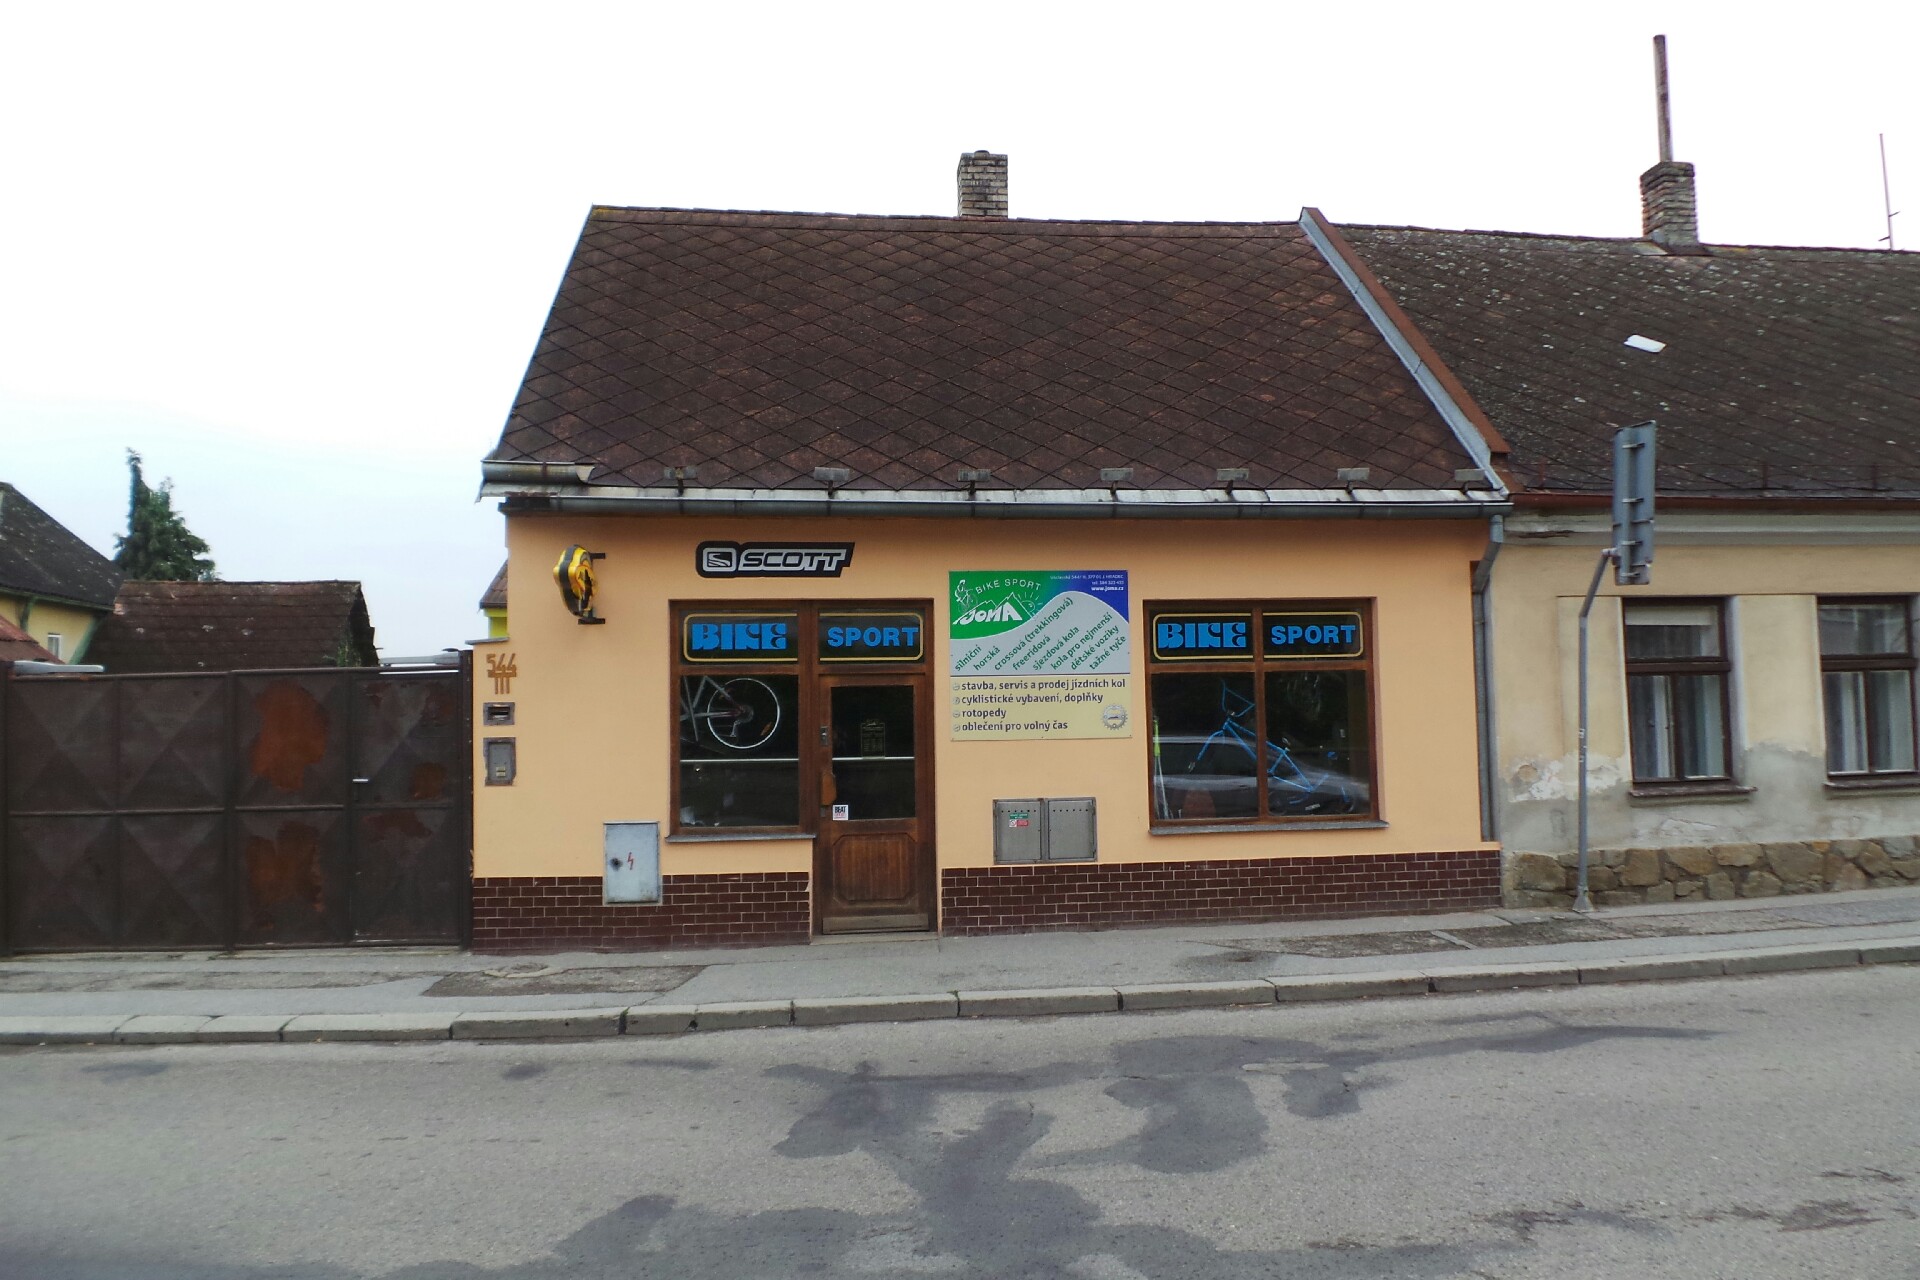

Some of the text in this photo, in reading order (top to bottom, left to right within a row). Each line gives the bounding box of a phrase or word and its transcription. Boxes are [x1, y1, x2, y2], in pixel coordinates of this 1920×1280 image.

[740, 550, 845, 571] SCOTT
[976, 578, 1042, 594] BIKE SPORT
[960, 602, 1023, 625] JOMA
[691, 623, 919, 650] BIKE SPORT
[994, 597, 1073, 670] crossová (trekkingová)
[1051, 612, 1112, 670] kola pro nejmenší
[1095, 625, 1119, 648] vozíky
[1157, 622, 1356, 649] BIKE SPORT
[955, 644, 982, 672] silniční
[973, 646, 1000, 671] horská
[1012, 635, 1050, 670] freeridová
[1033, 626, 1079, 670] sjezdová kola
[1089, 636, 1126, 670] tažné tyče
[486, 653, 517, 673] 544
[961, 681, 997, 691] stavba,
[999, 680, 1028, 690] servis
[1038, 680, 1069, 692] prodej
[1070, 679, 1108, 691] jízdních
[1112, 679, 1126, 688] kol
[961, 693, 1104, 705] cyklistické vybavení, doplňky
[962, 708, 1006, 719] rotopedy
[962, 720, 1068, 732] oblečení pro volný čas
